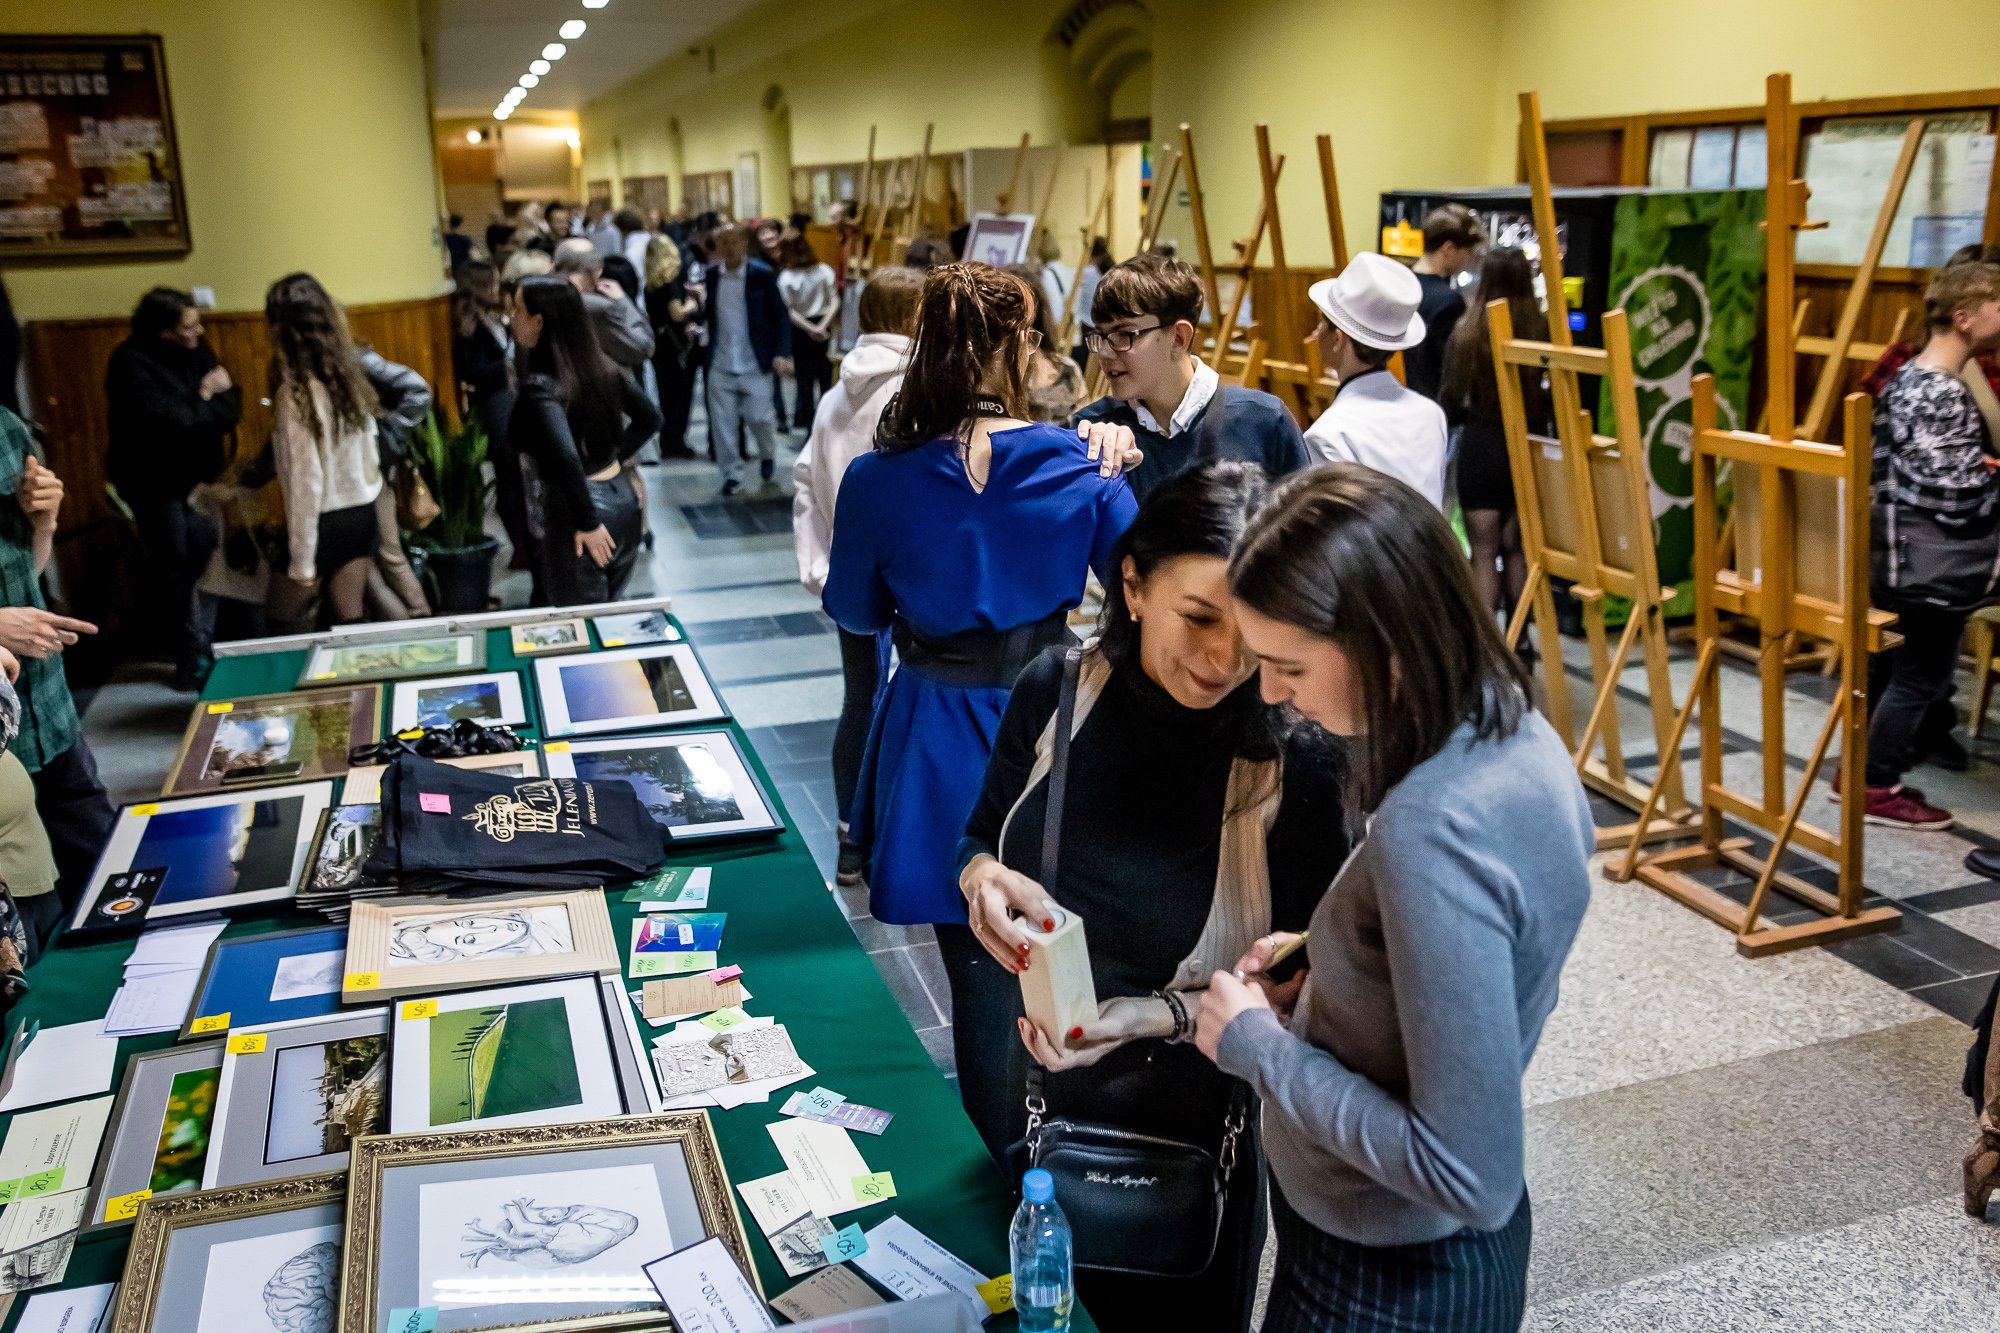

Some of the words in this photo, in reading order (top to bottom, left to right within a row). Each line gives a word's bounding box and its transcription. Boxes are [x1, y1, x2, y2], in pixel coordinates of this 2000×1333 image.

[810, 1093, 833, 1109] 90,-
[29, 1173, 56, 1191] 80,-
[862, 1177, 886, 1198] 80,-
[836, 1233, 856, 1257] 50,-
[701, 1283, 723, 1308] 200
